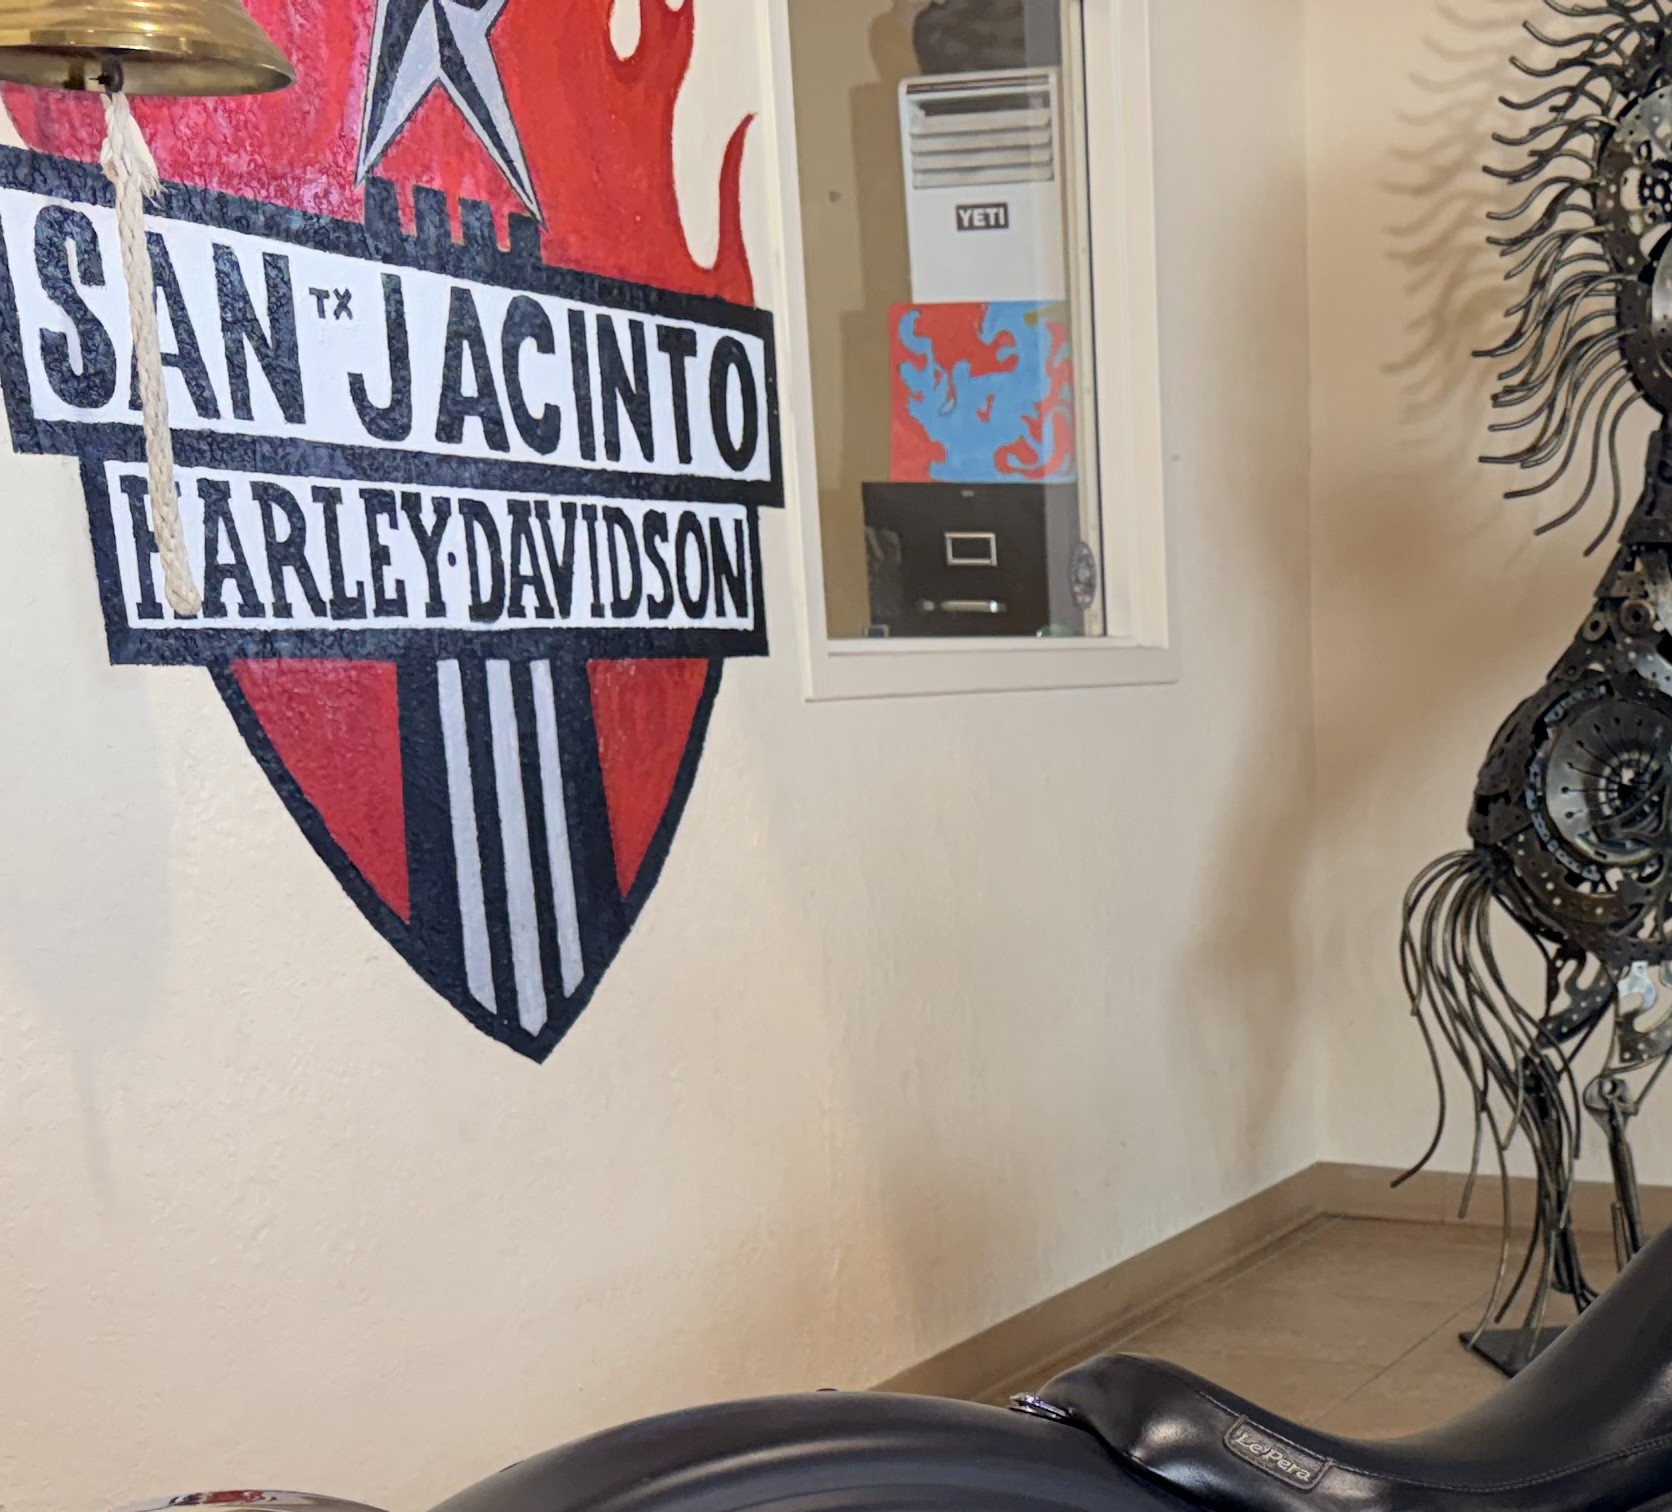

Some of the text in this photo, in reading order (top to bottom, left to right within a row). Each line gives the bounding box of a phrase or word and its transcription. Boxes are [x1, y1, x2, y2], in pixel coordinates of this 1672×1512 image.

[957, 206, 1006, 228] YETI
[309, 287, 353, 320] TX
[35, 205, 758, 471] SAN JACINTO
